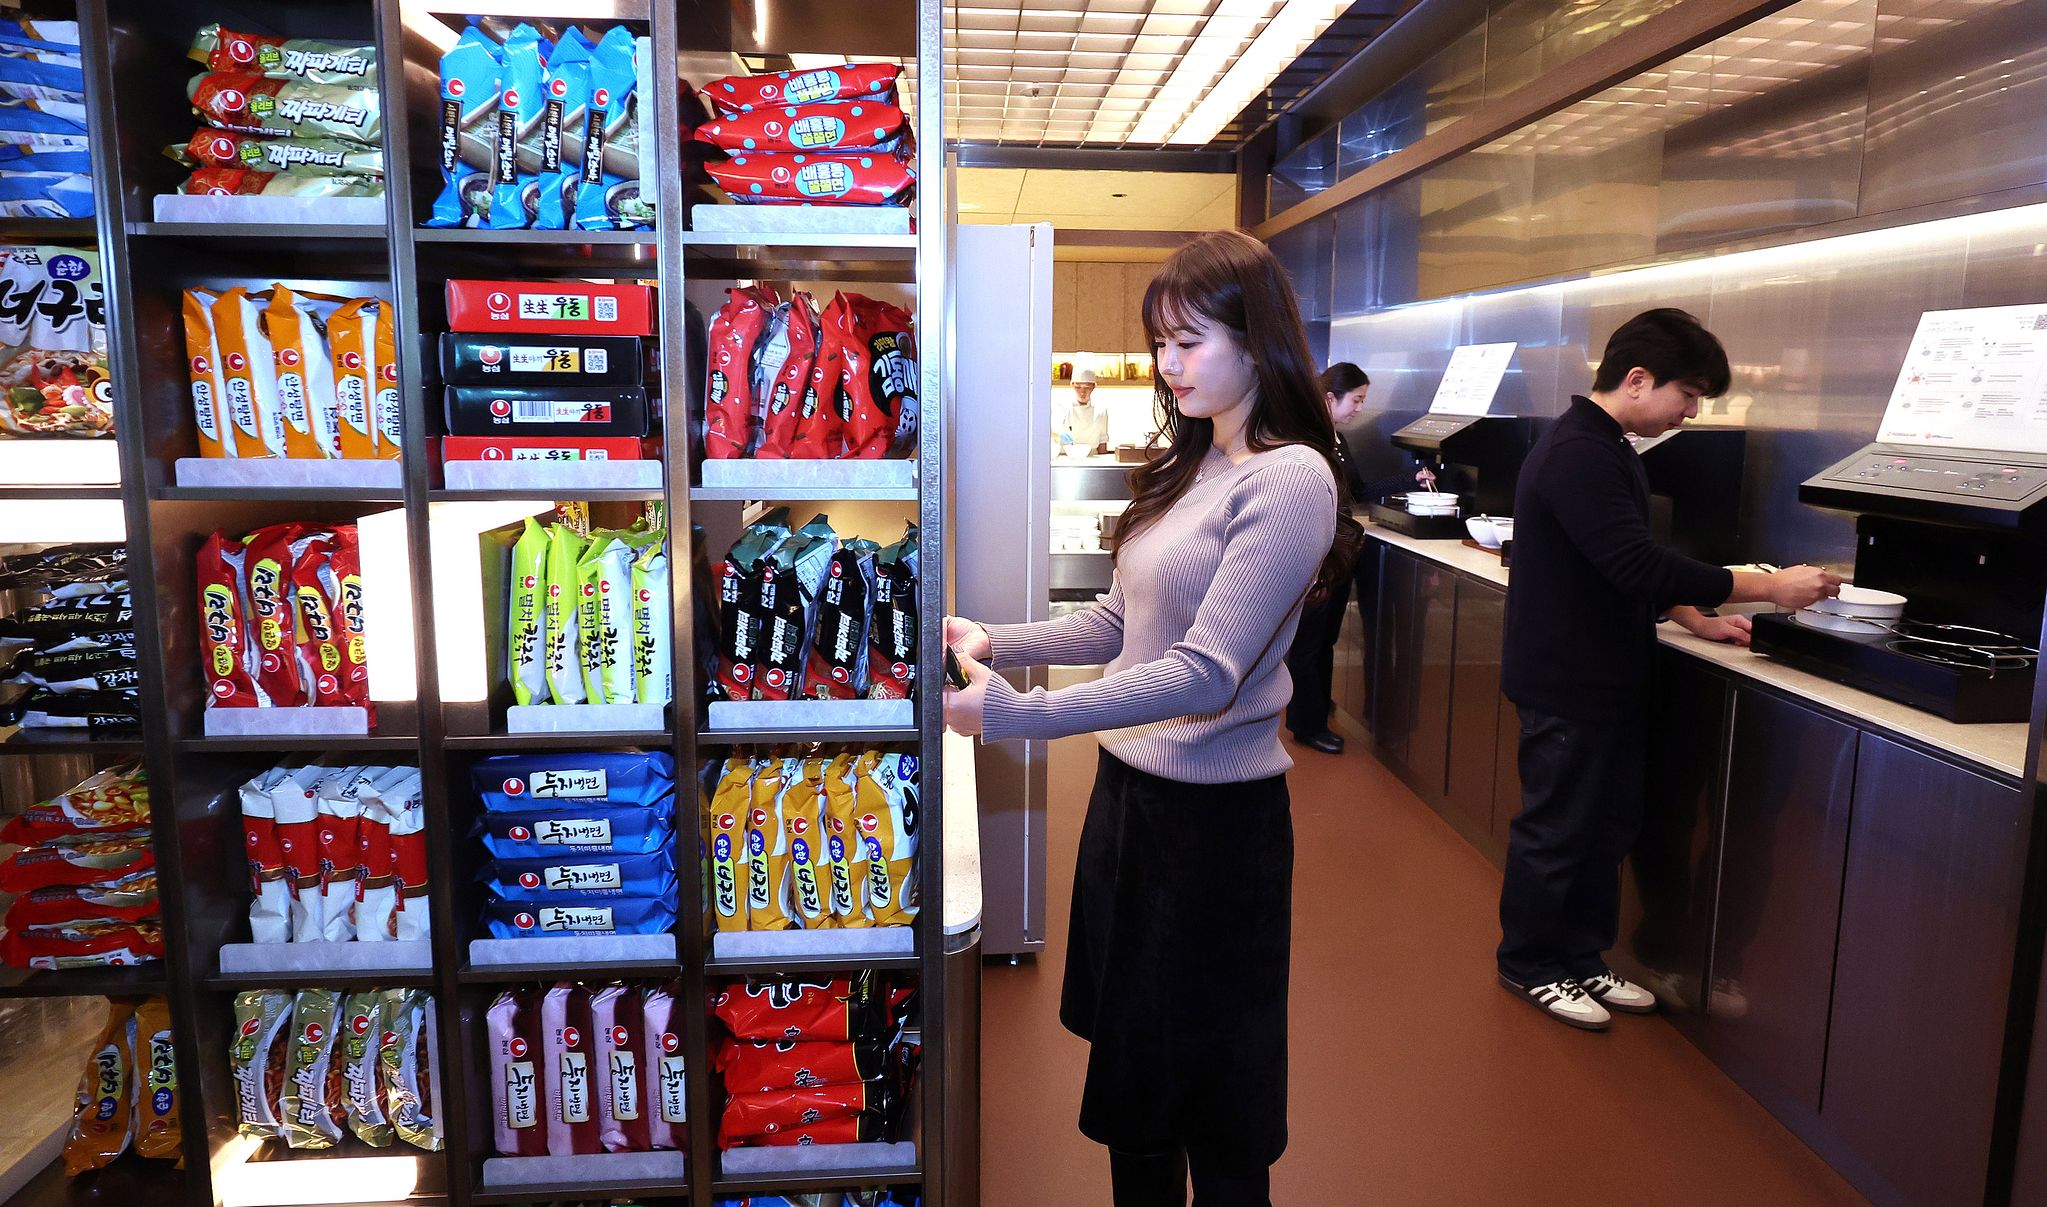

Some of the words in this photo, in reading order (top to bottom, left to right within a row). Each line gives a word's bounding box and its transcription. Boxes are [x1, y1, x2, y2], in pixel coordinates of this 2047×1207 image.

[285, 50, 368, 75] 짜파게티
[280, 99, 367, 126] 짜파게티
[794, 117, 837, 134] 배홍동
[267, 144, 346, 169] 짜파게티
[442, 126, 456, 168] 메밀소바
[499, 137, 513, 181] 메밀소바
[545, 126, 559, 168] 메밀소바
[586, 137, 601, 180] 메밀소바
[802, 162, 845, 182] 배홍동
[56, 260, 83, 276] 순한
[490, 312, 510, 320] 농심
[482, 365, 501, 373] 농심
[710, 371, 724, 404] 김통깨
[195, 384, 213, 429] 안성탕면
[233, 381, 253, 425] 안성탕면
[285, 377, 305, 423] 안성탕면
[347, 379, 364, 423] 안성탕면
[771, 382, 788, 415] 김통깨
[802, 388, 816, 419] 김통깨
[254, 567, 276, 617] 너구리
[344, 583, 364, 632] 너구리
[207, 591, 229, 642] 너구리
[263, 621, 275, 648] 얼큰한
[302, 595, 330, 641] 너구리
[735, 609, 751, 659] 짜파게티
[893, 608, 909, 658] 짜파게티
[770, 615, 787, 664] 짜파게티
[834, 612, 852, 662] 짜파게티
[536, 771, 600, 797] 둥지냉면
[542, 820, 605, 845] 둥지냉면
[717, 838, 728, 857] 순한
[752, 832, 761, 851] 순한
[795, 842, 806, 860] 순한
[832, 838, 842, 858] 순한
[552, 866, 614, 889] 둥지냉면
[718, 865, 733, 909] 너구리
[751, 858, 768, 905] 너구리
[798, 868, 818, 911] 너구리
[836, 865, 851, 909] 너구리
[870, 863, 888, 900] 너구리
[546, 907, 607, 930] 둥지냉면
[502, 1040, 509, 1055] 농심
[556, 1028, 563, 1045] 농심
[605, 1027, 611, 1043] 농심
[655, 1034, 661, 1049] 농심
[98, 1054, 119, 1093] 너구리
[153, 1039, 173, 1084] 너구리
[157, 1092, 169, 1110] 순한
[234, 1065, 257, 1122] 짜파게티
[507, 1067, 534, 1122] 둥지냉면
[561, 1057, 586, 1117] 둥지냉면
[611, 1055, 634, 1113] 둥지냉면
[660, 1061, 685, 1117] 둥지냉면
